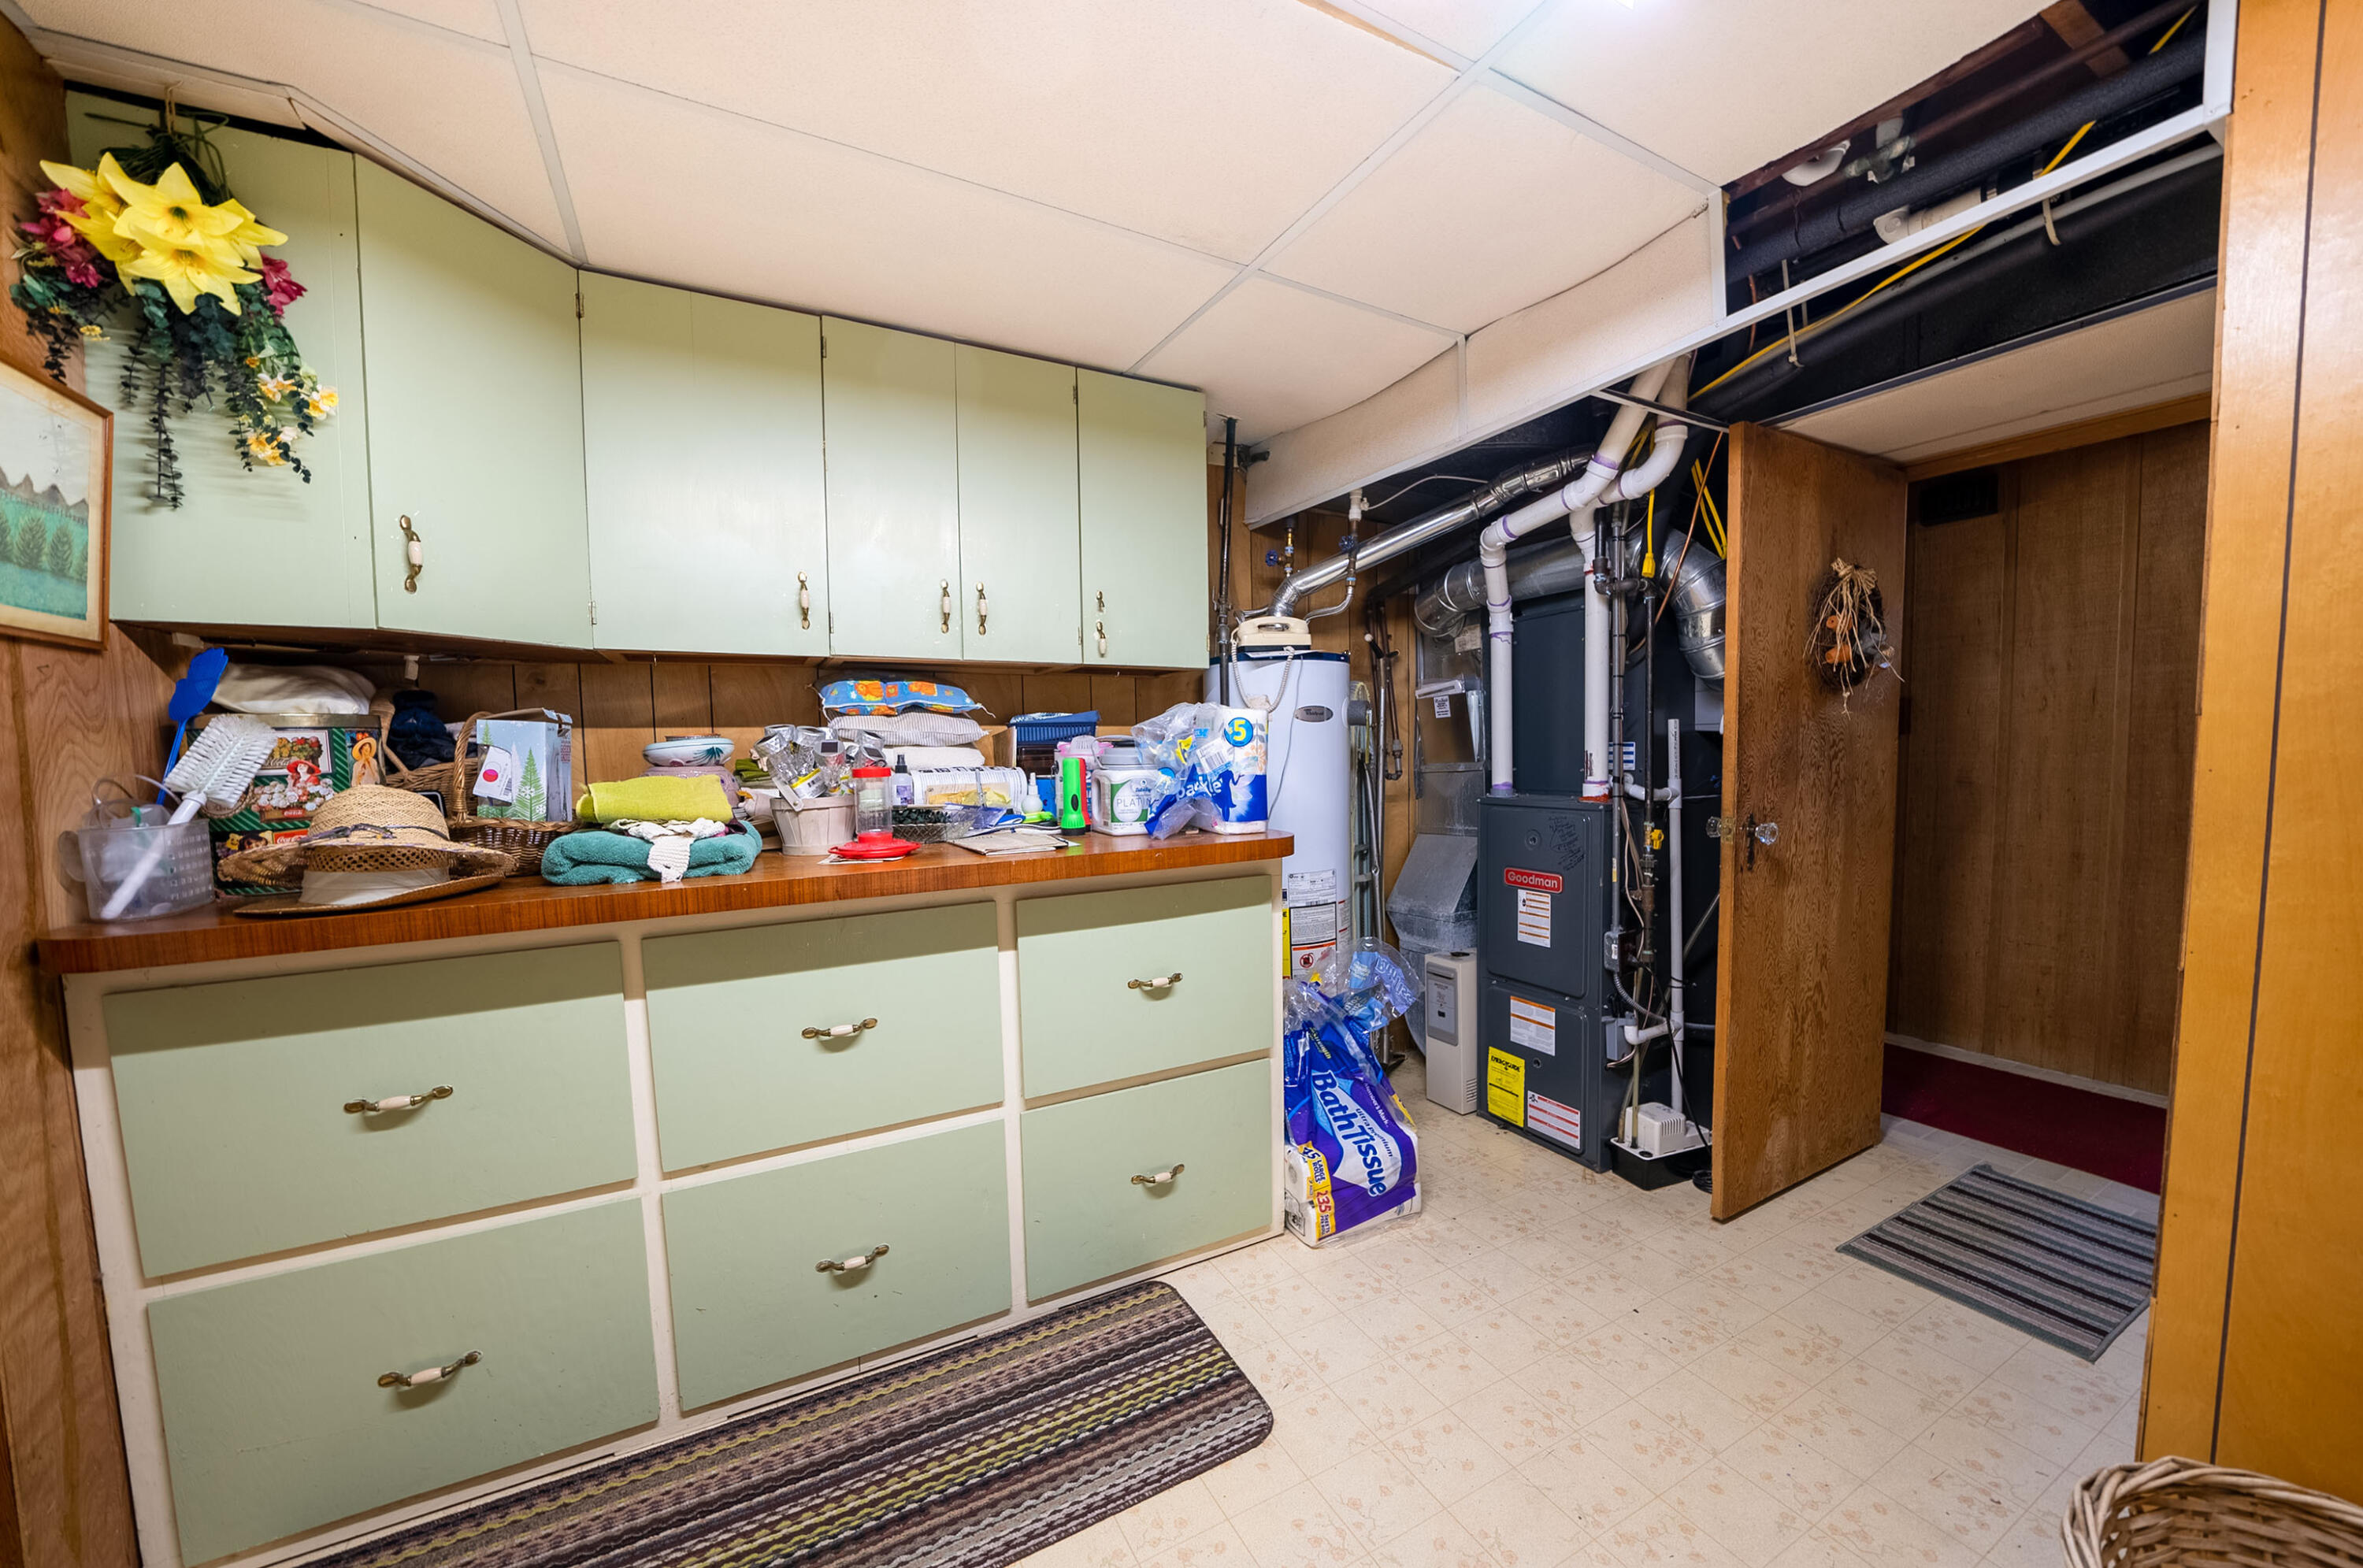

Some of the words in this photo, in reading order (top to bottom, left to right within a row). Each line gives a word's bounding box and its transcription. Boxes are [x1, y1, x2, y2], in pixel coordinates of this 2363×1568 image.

[1508, 871, 1557, 888] Goodman
[1303, 1147, 1321, 1159] 45
[1317, 1159, 1326, 1181] LARGE
[1316, 1190, 1331, 1213] 235
